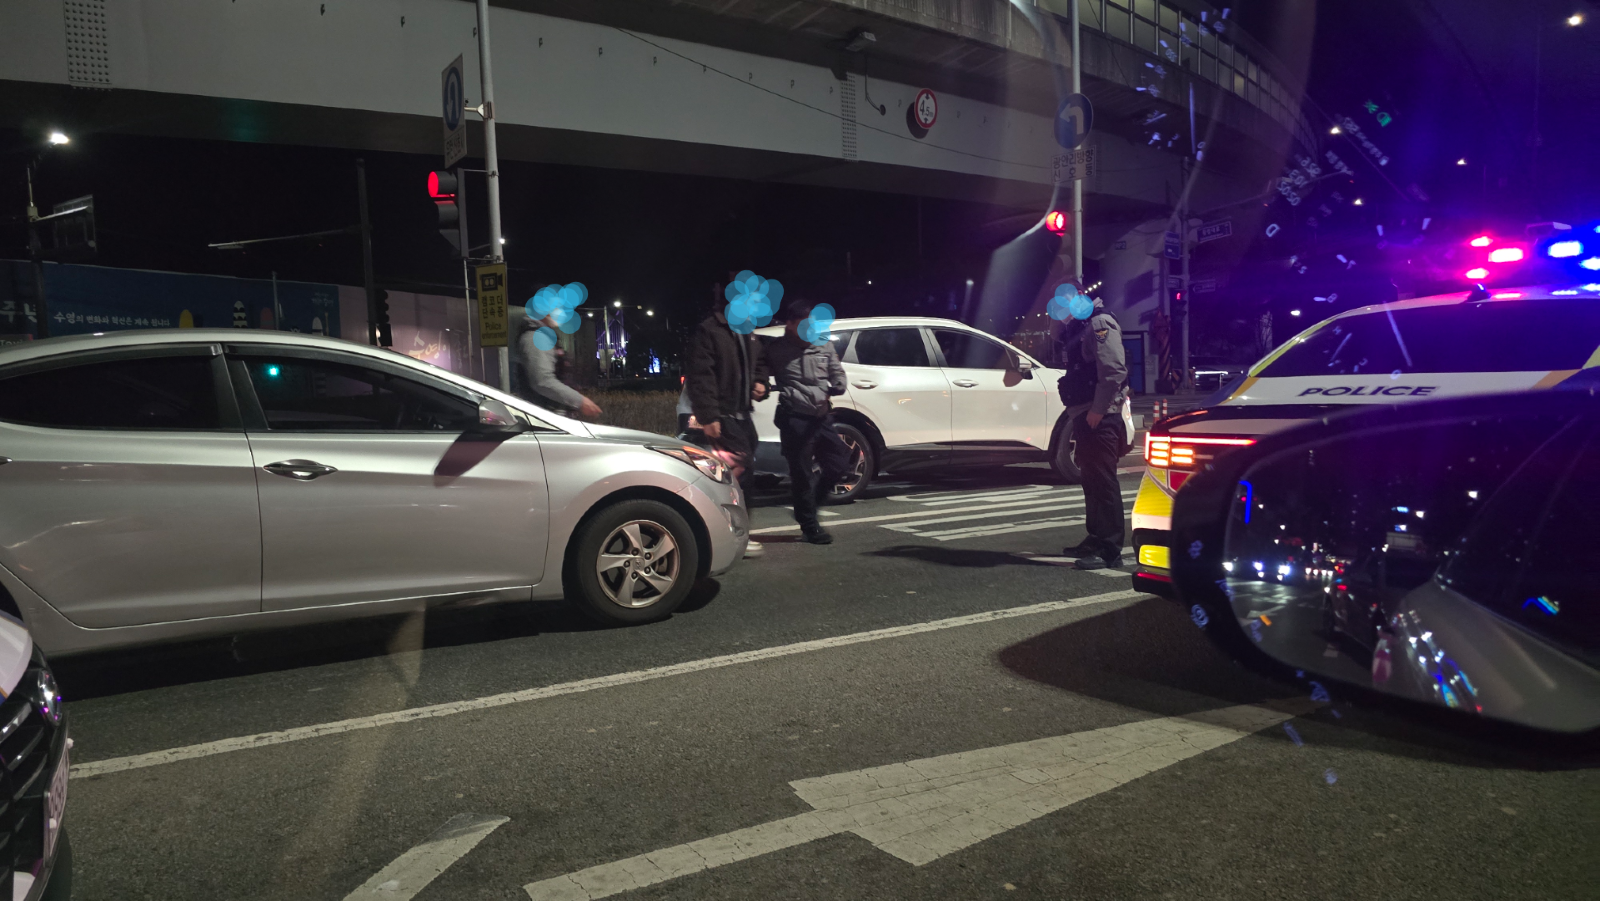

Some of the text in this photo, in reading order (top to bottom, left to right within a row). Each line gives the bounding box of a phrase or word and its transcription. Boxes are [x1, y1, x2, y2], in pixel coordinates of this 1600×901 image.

[1053, 148, 1094, 170] 광안리방향
[1053, 163, 1093, 182] 신호등
[53, 311, 84, 325] 수영의
[86, 314, 110, 325] 변화와
[111, 315, 133, 326] 혁신은
[134, 317, 150, 326] 계속
[485, 321, 502, 331] Police
[1297, 386, 1438, 397] POLICE
